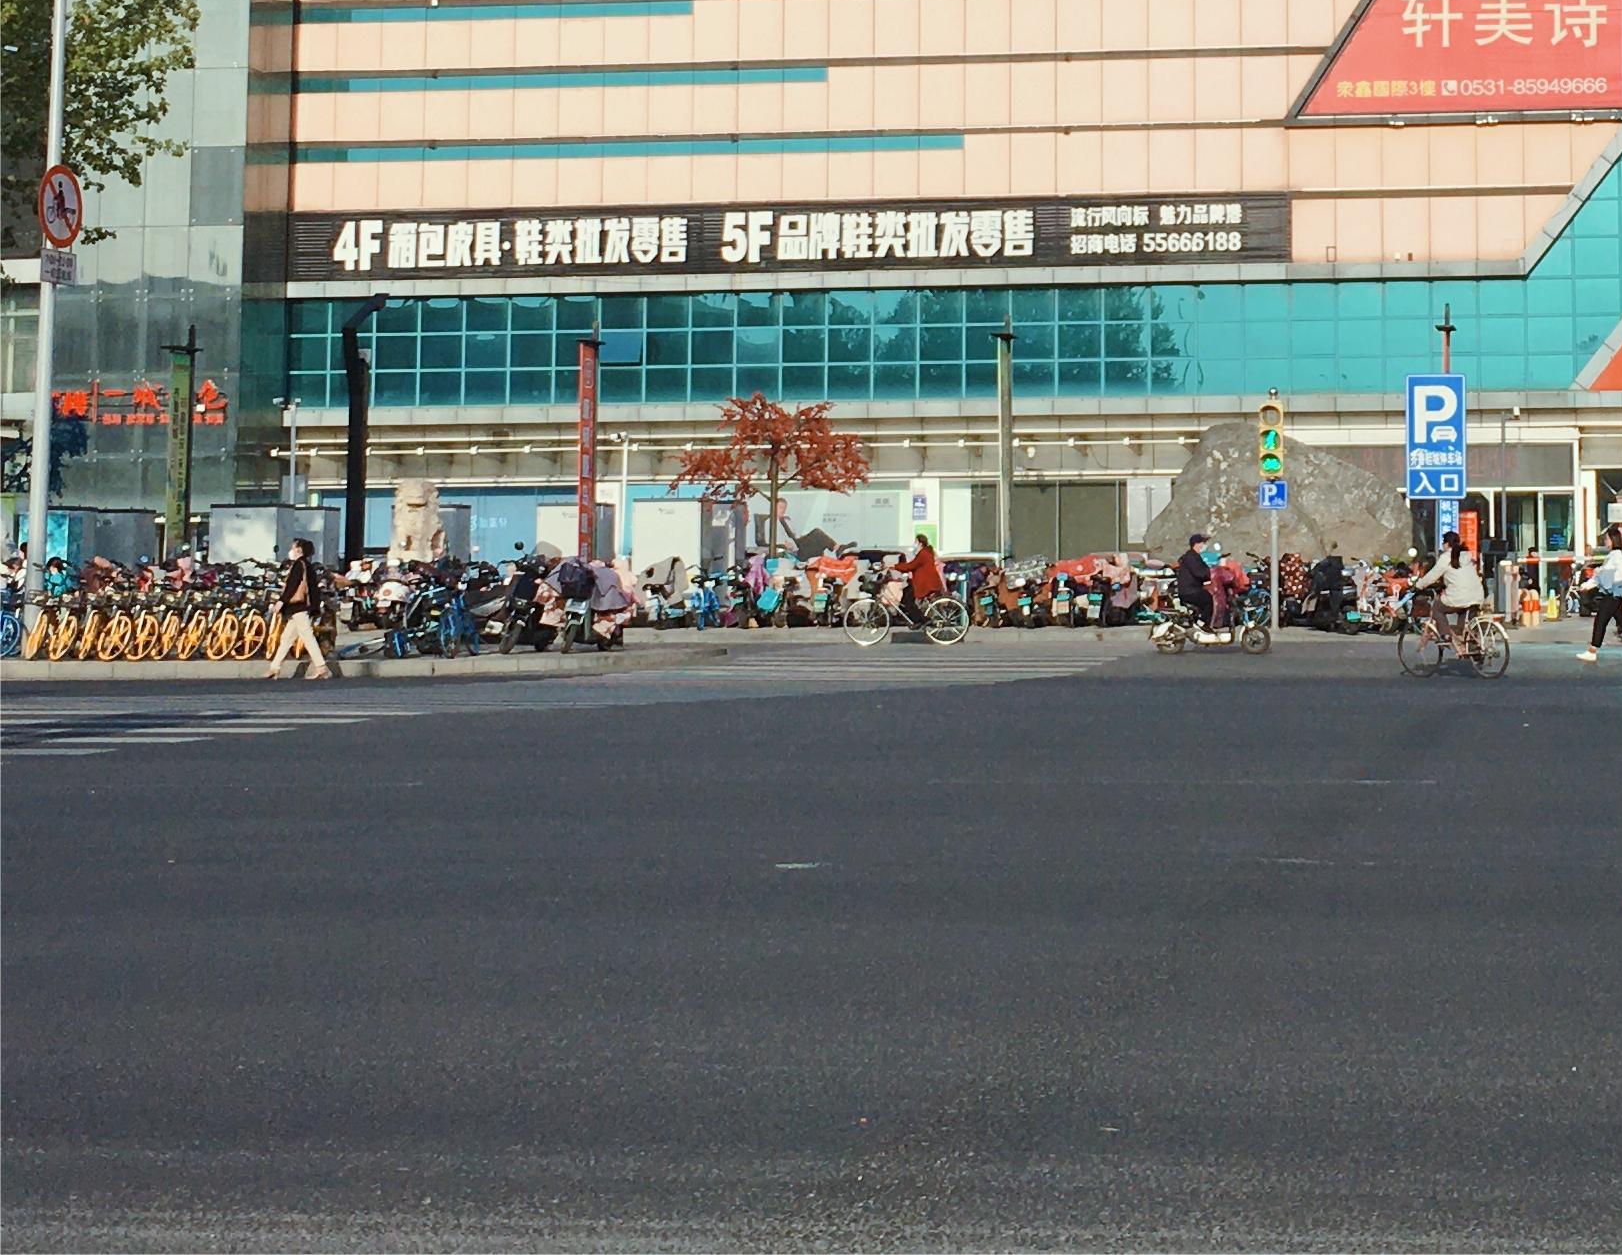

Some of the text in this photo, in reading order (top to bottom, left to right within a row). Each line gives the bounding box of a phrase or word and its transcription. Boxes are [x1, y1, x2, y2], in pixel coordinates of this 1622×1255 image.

[1460, 77, 1608, 97] 0531-85949666
[333, 219, 384, 272] 4F
[721, 207, 1034, 263] 5F 品牌鞋类批发零售
[1070, 231, 1242, 255] 招商电话 55666188
[1414, 385, 1458, 444] P
[1414, 471, 1460, 495] 入口
